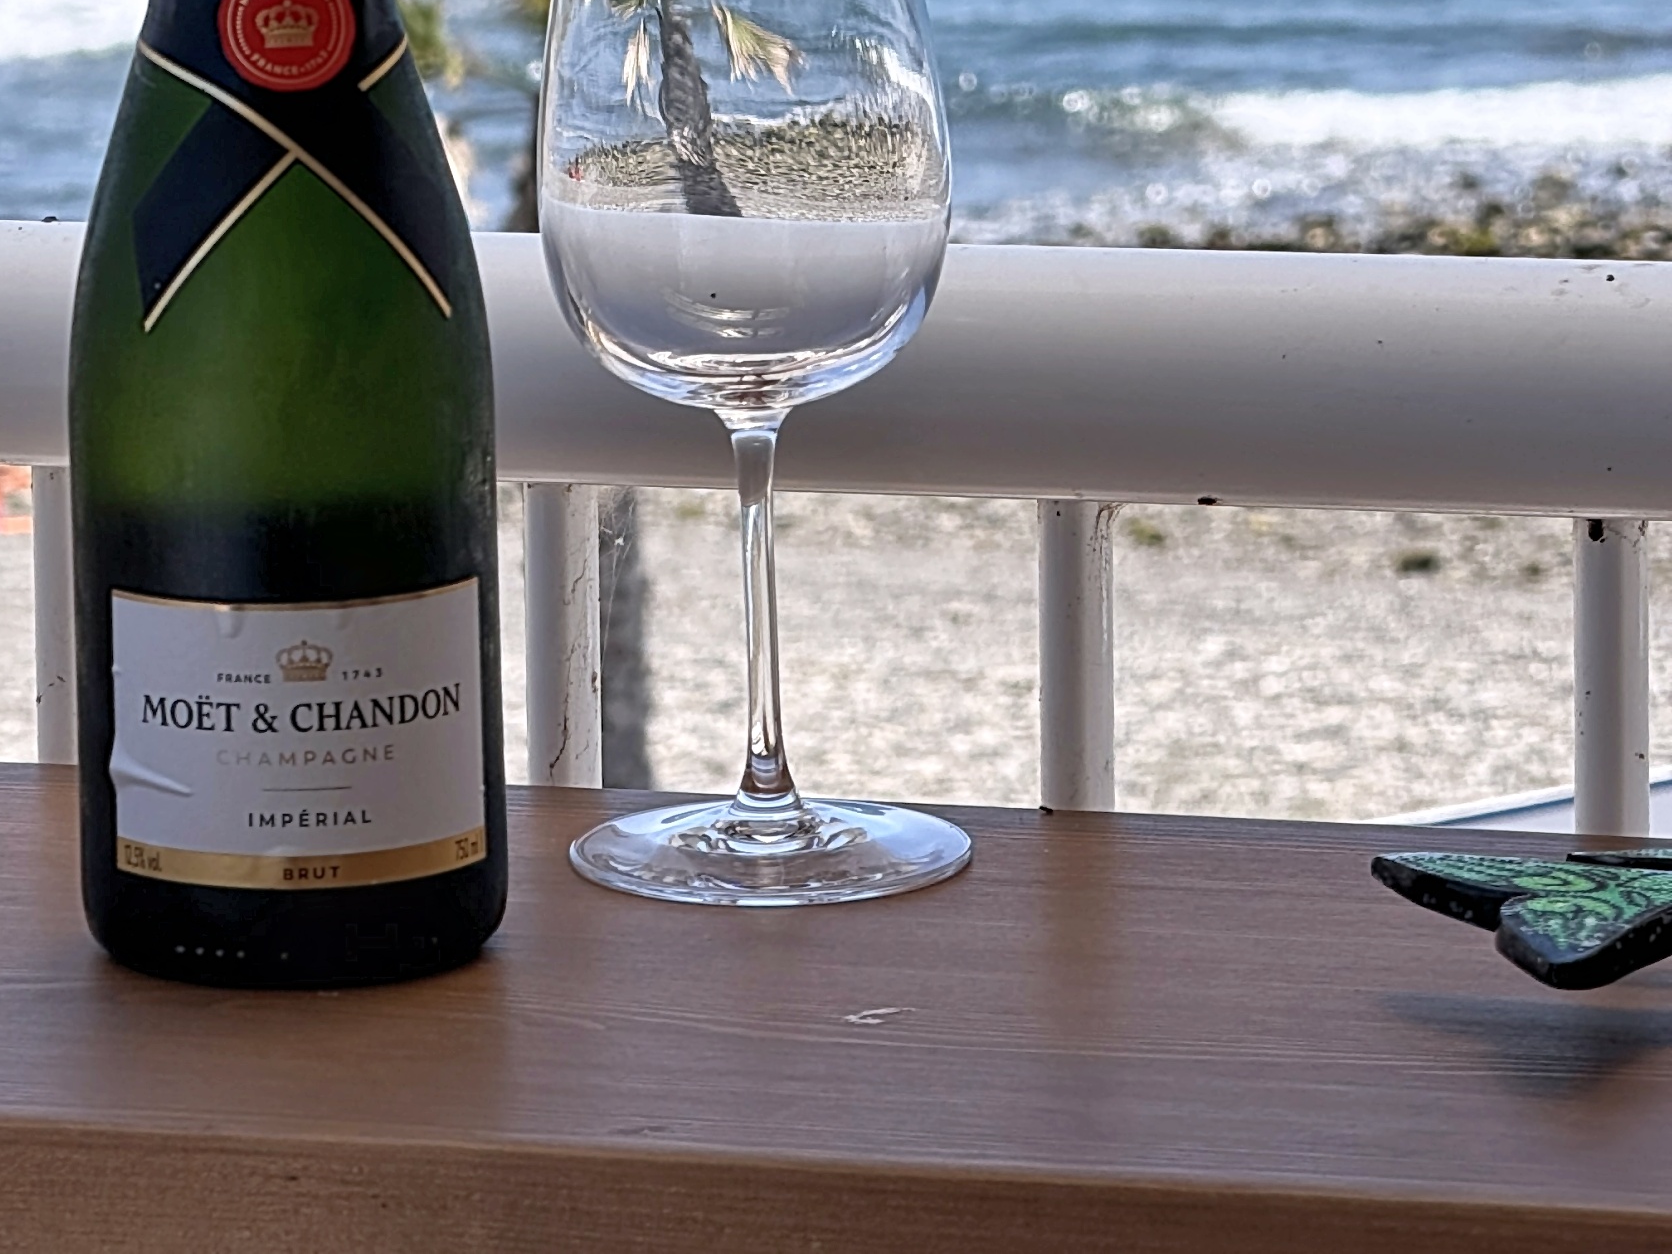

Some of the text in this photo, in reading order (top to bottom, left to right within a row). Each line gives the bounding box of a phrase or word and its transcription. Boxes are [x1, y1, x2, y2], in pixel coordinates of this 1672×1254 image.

[216, 667, 384, 685] FRANCE 1743
[141, 682, 461, 734] MOËT & CHANDON
[216, 745, 395, 767] CHAMPAGNE
[247, 808, 372, 828] IMPÉRIAL
[283, 865, 341, 882] BRUT
